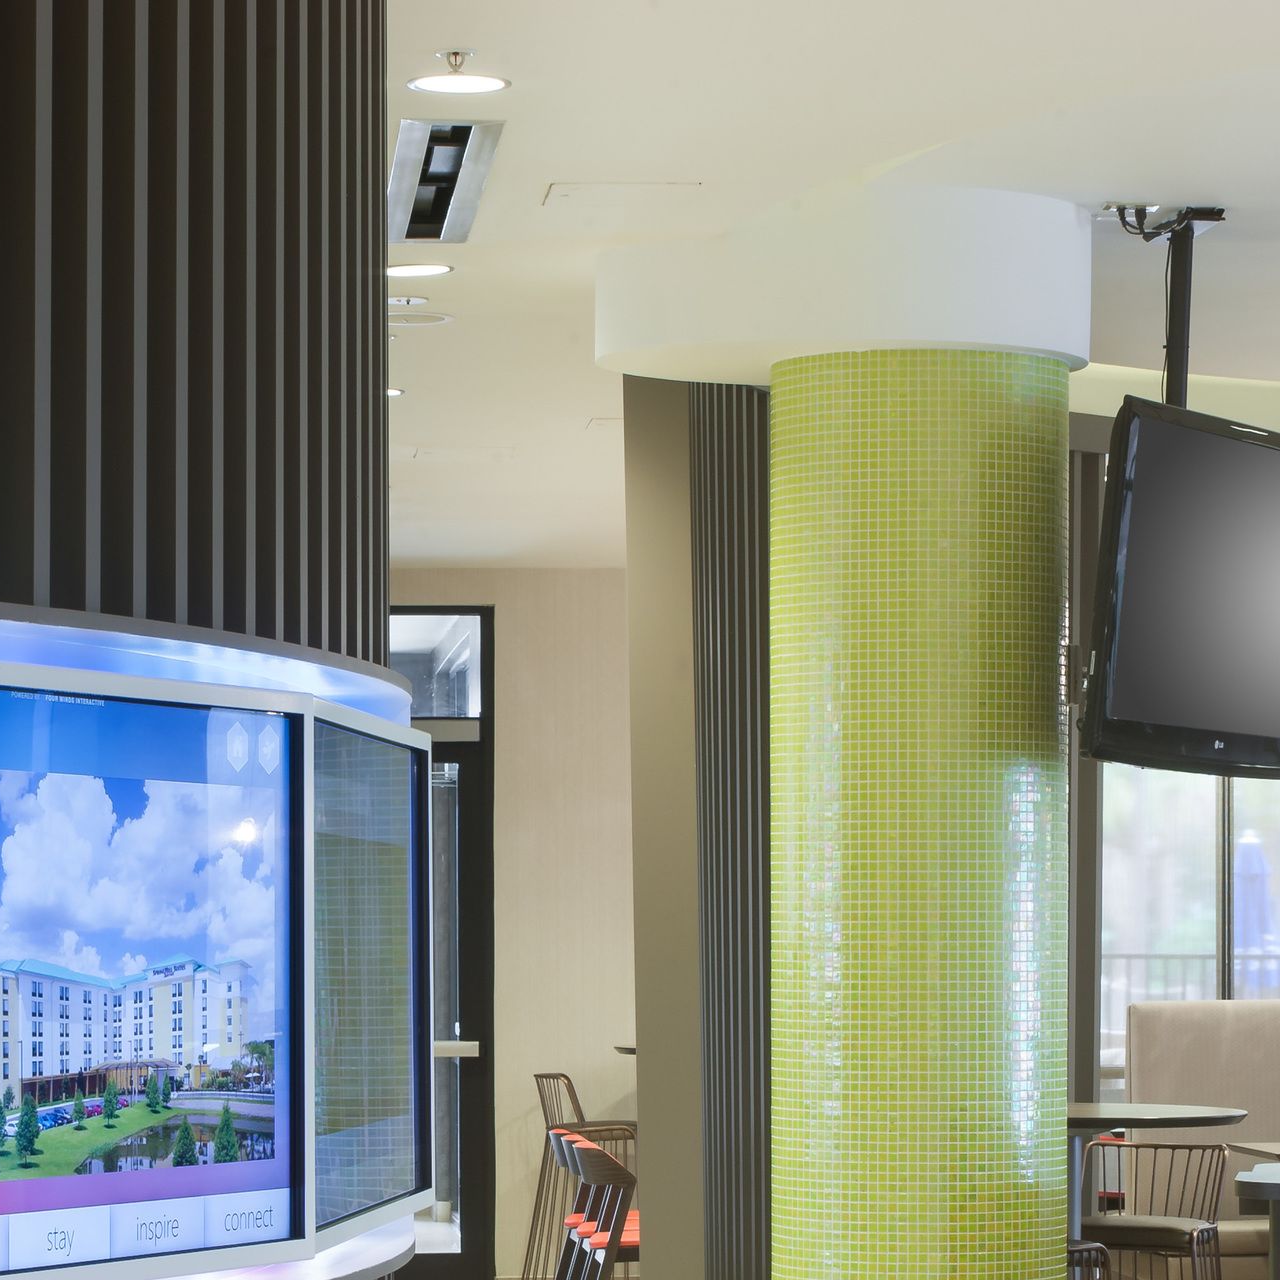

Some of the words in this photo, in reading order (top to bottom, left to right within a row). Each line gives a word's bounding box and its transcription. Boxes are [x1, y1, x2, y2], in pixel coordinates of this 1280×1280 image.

[136, 1215, 180, 1243] inspire
[224, 1204, 275, 1233] connect
[47, 1224, 76, 1258] stay
